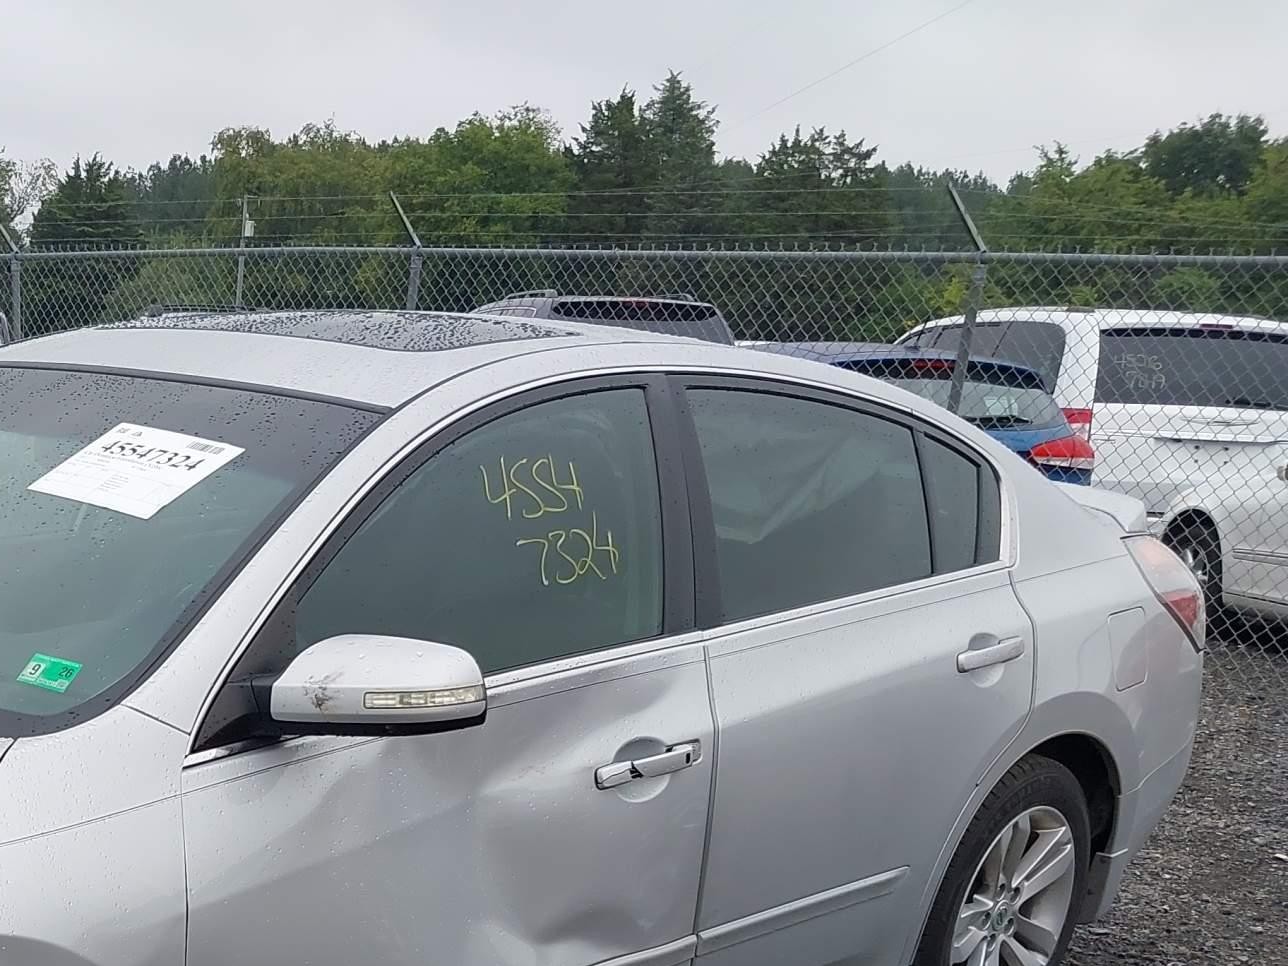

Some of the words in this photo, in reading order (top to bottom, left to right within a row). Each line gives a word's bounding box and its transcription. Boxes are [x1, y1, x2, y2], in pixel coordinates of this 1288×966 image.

[101, 440, 206, 471] 45547324
[479, 453, 585, 521] 4554
[516, 510, 619, 586] 7324
[28, 663, 42, 676] 9
[58, 666, 75, 679] 26
